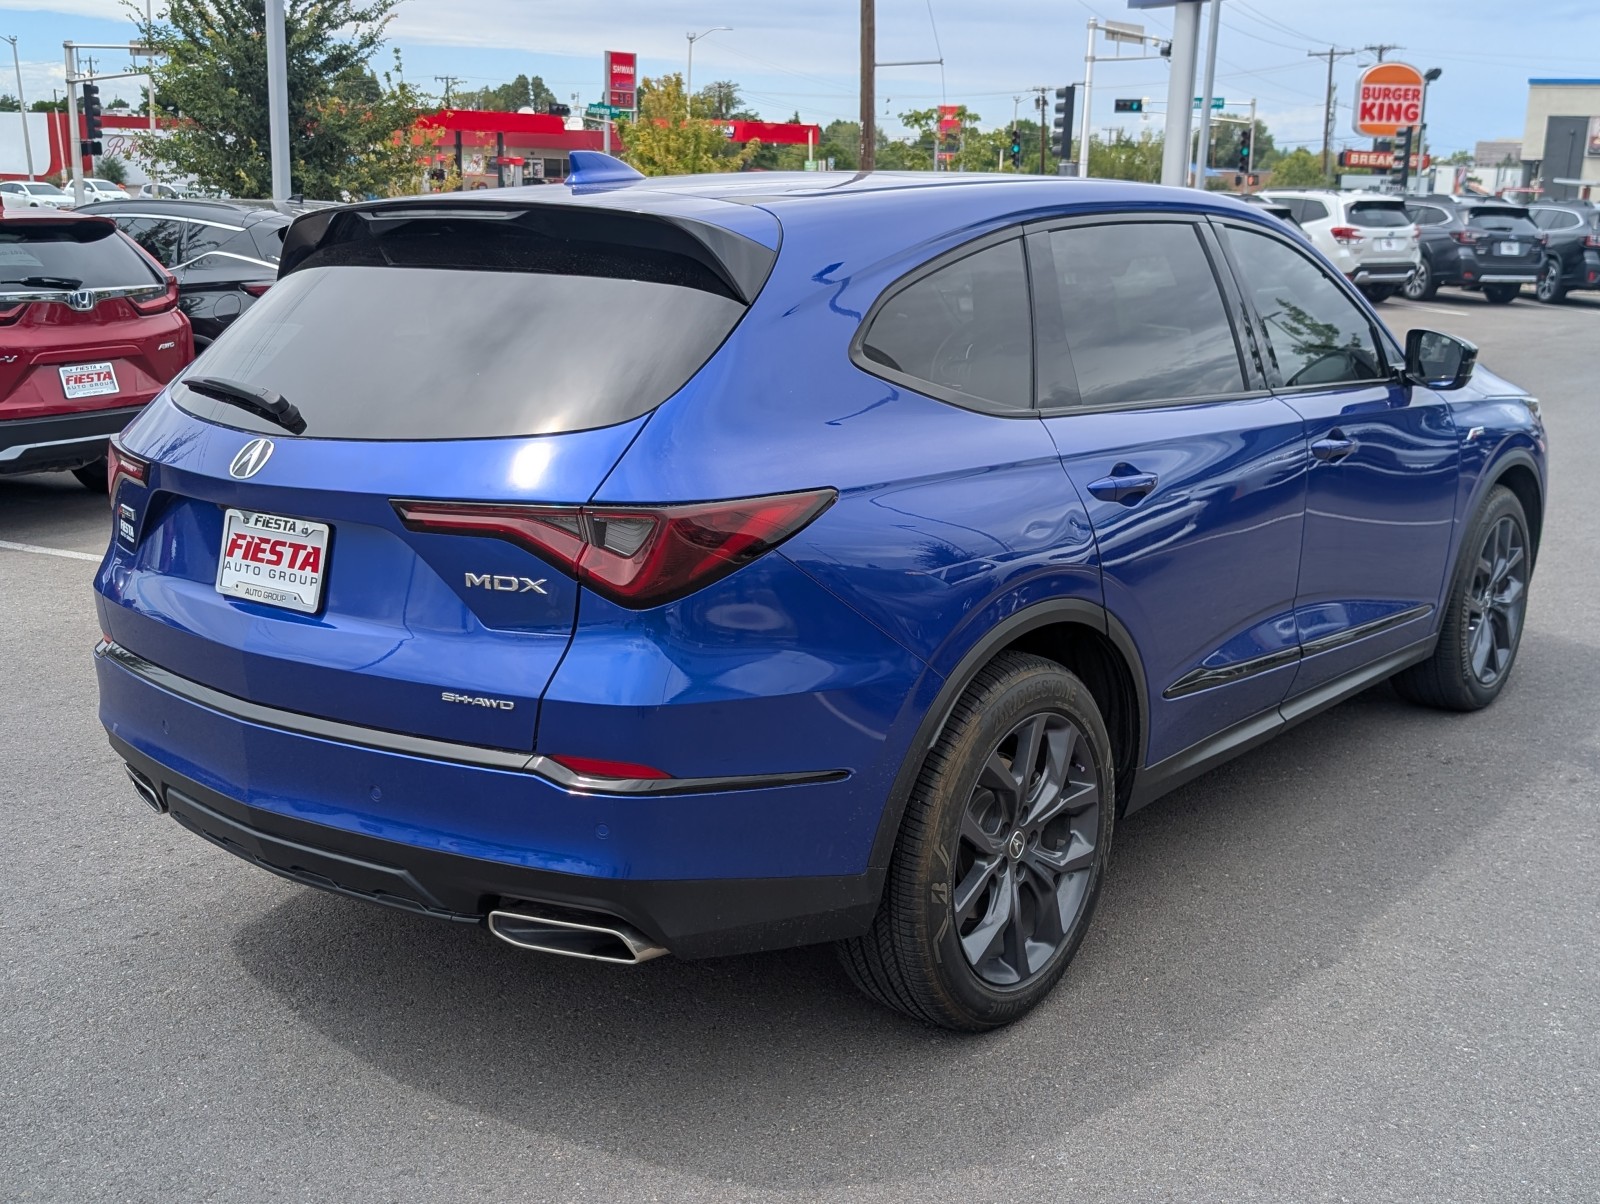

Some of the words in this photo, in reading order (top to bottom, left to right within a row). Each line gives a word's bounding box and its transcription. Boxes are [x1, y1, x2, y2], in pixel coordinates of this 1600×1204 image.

[1361, 87, 1422, 101] BURGER
[1360, 102, 1419, 122] KING
[1350, 153, 1424, 168] BREAKS
[65, 371, 112, 386] FIESTA
[254, 515, 297, 533] FIESTA
[226, 533, 321, 574] FIESTA
[224, 561, 261, 576] AUTO
[268, 569, 318, 586] GROUP
[465, 572, 548, 595] MDX
[244, 587, 262, 598] AUTO
[263, 591, 287, 602] GROUP
[441, 692, 514, 710] SH-AWD
